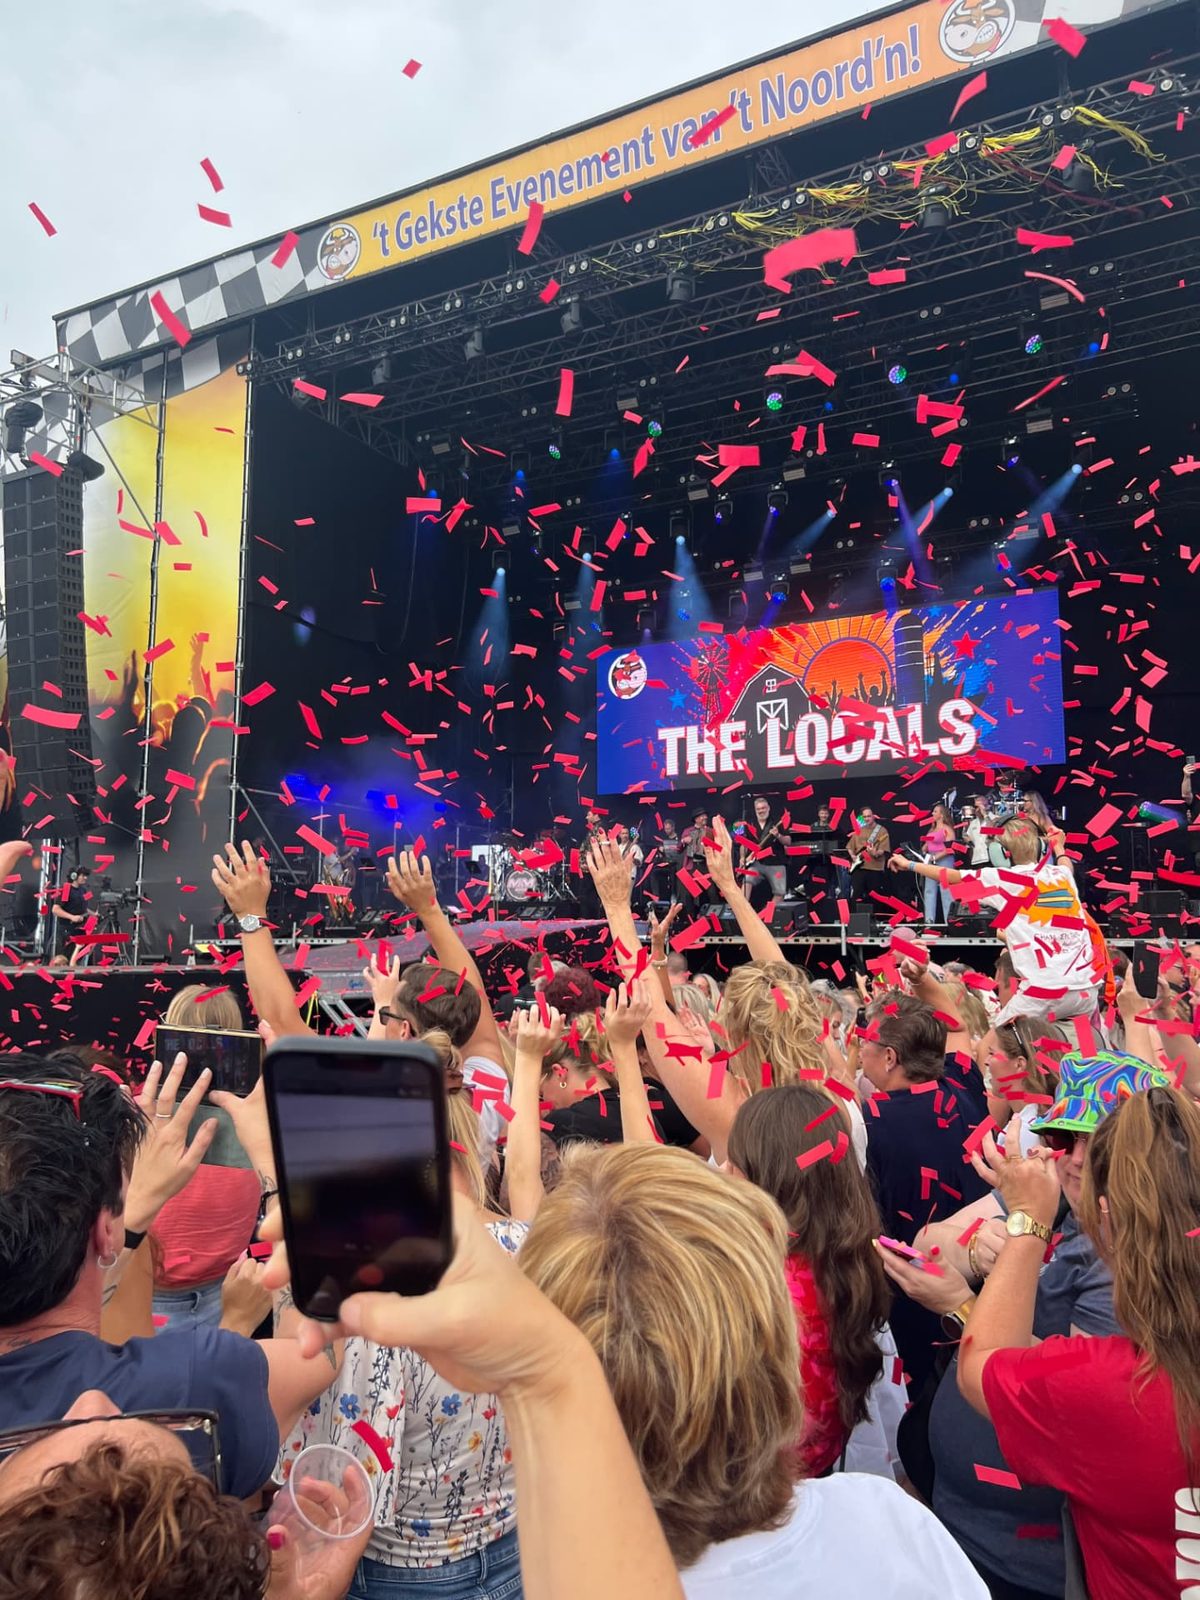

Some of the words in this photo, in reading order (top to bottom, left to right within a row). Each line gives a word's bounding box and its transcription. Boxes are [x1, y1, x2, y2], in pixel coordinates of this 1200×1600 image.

[395, 193, 483, 250] Gekste
[490, 125, 655, 220] Evenement
[661, 108, 722, 158] van
[760, 23, 921, 126] Noord'n!
[657, 720, 748, 776] THE
[767, 698, 977, 769] LOCALS
